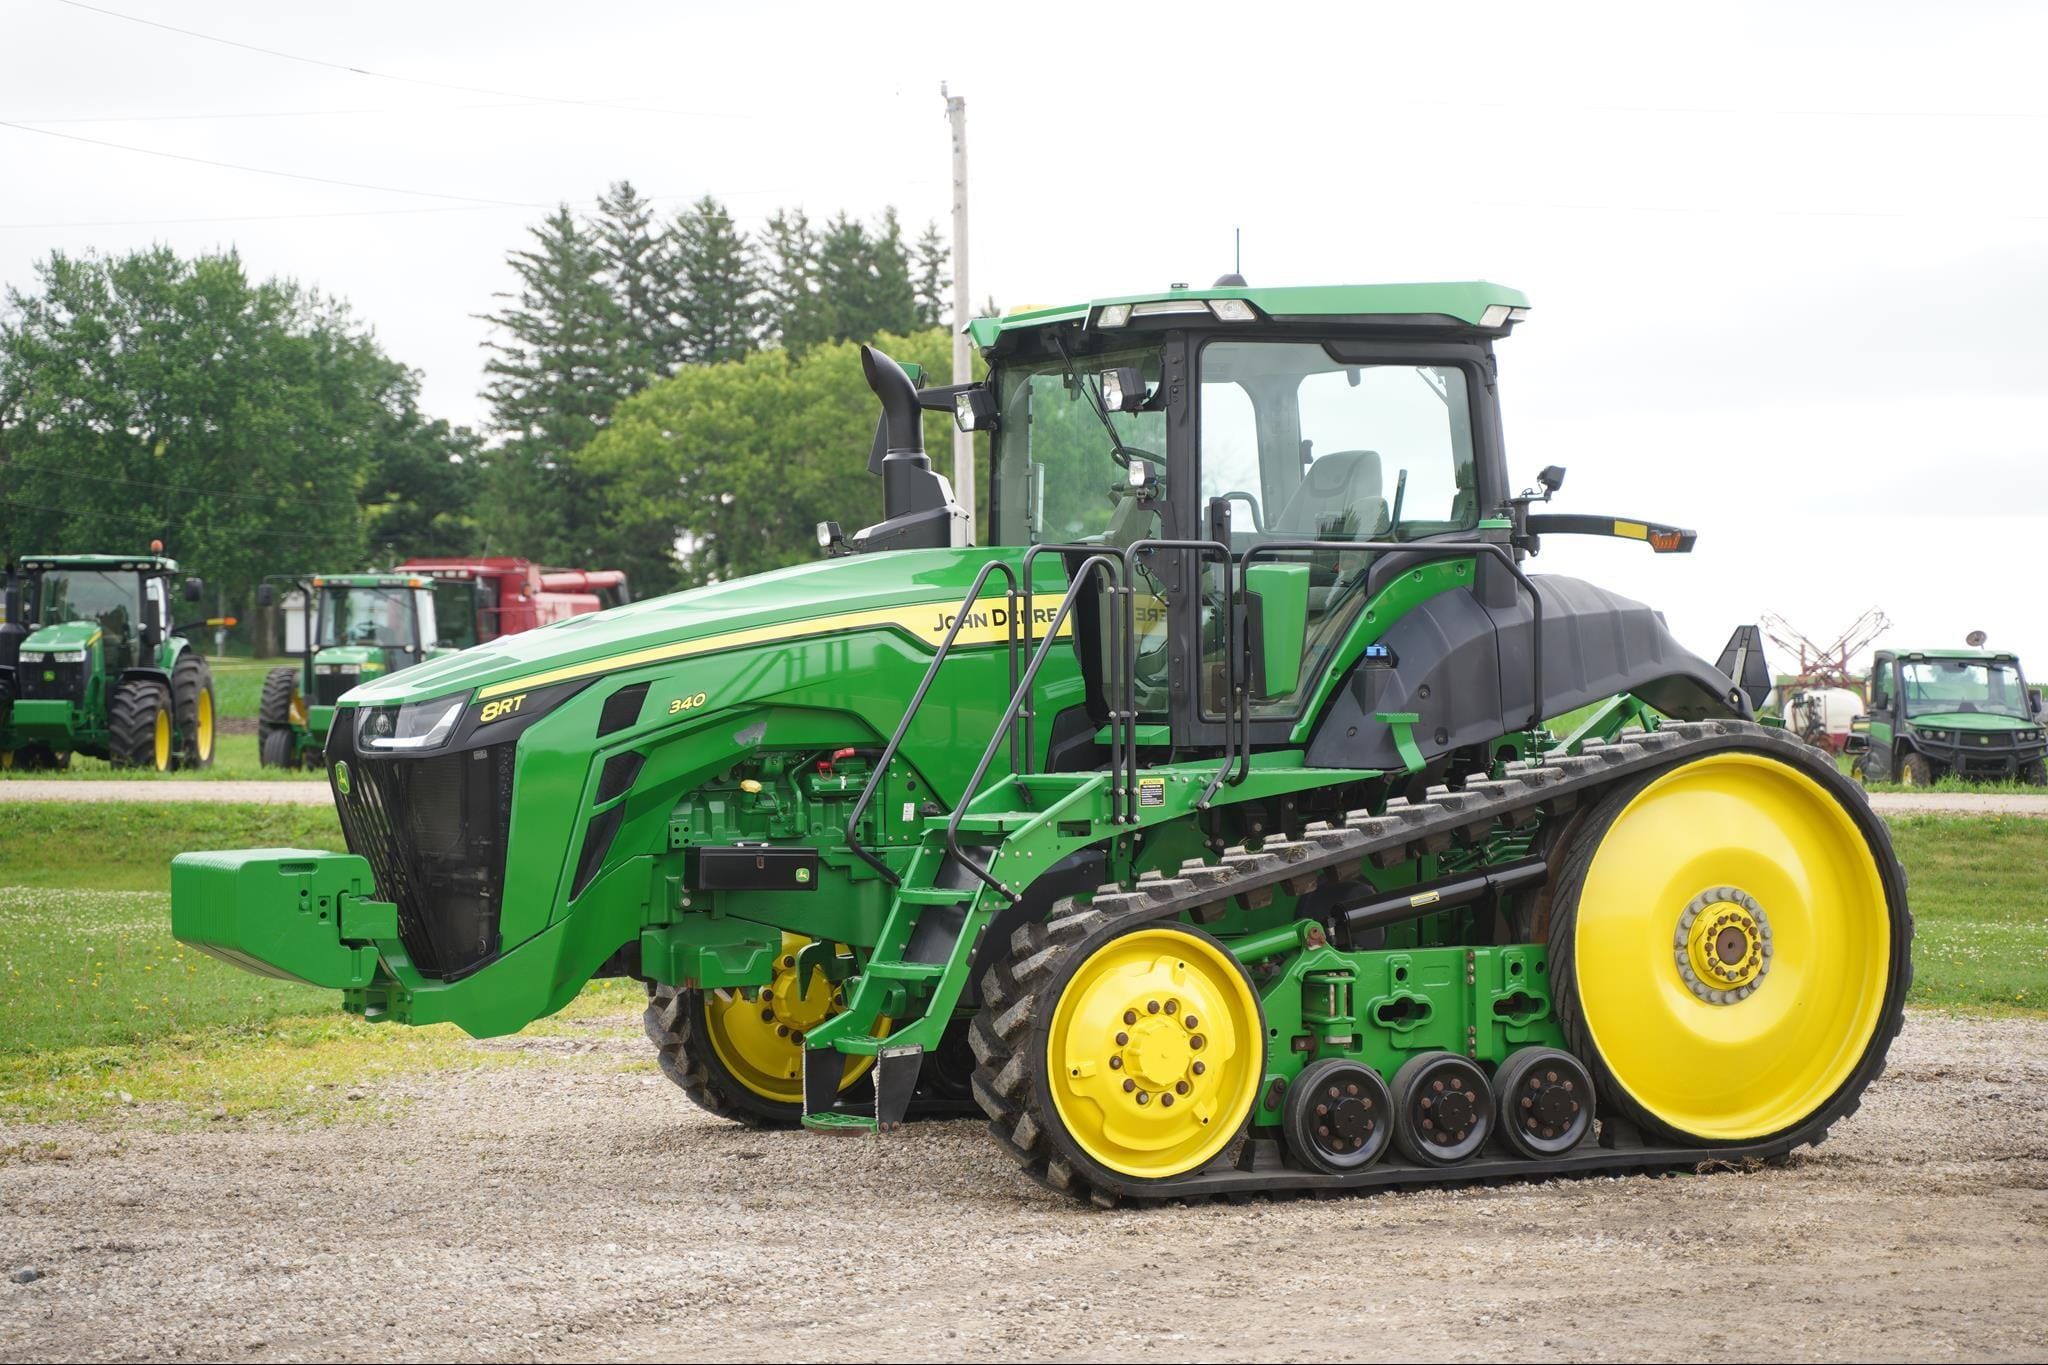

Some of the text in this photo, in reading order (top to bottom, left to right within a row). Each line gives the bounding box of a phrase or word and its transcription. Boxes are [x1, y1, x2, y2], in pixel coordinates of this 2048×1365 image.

[992, 608, 1058, 627] DRE
[480, 694, 527, 722] 8RT
[668, 692, 707, 715] 340
